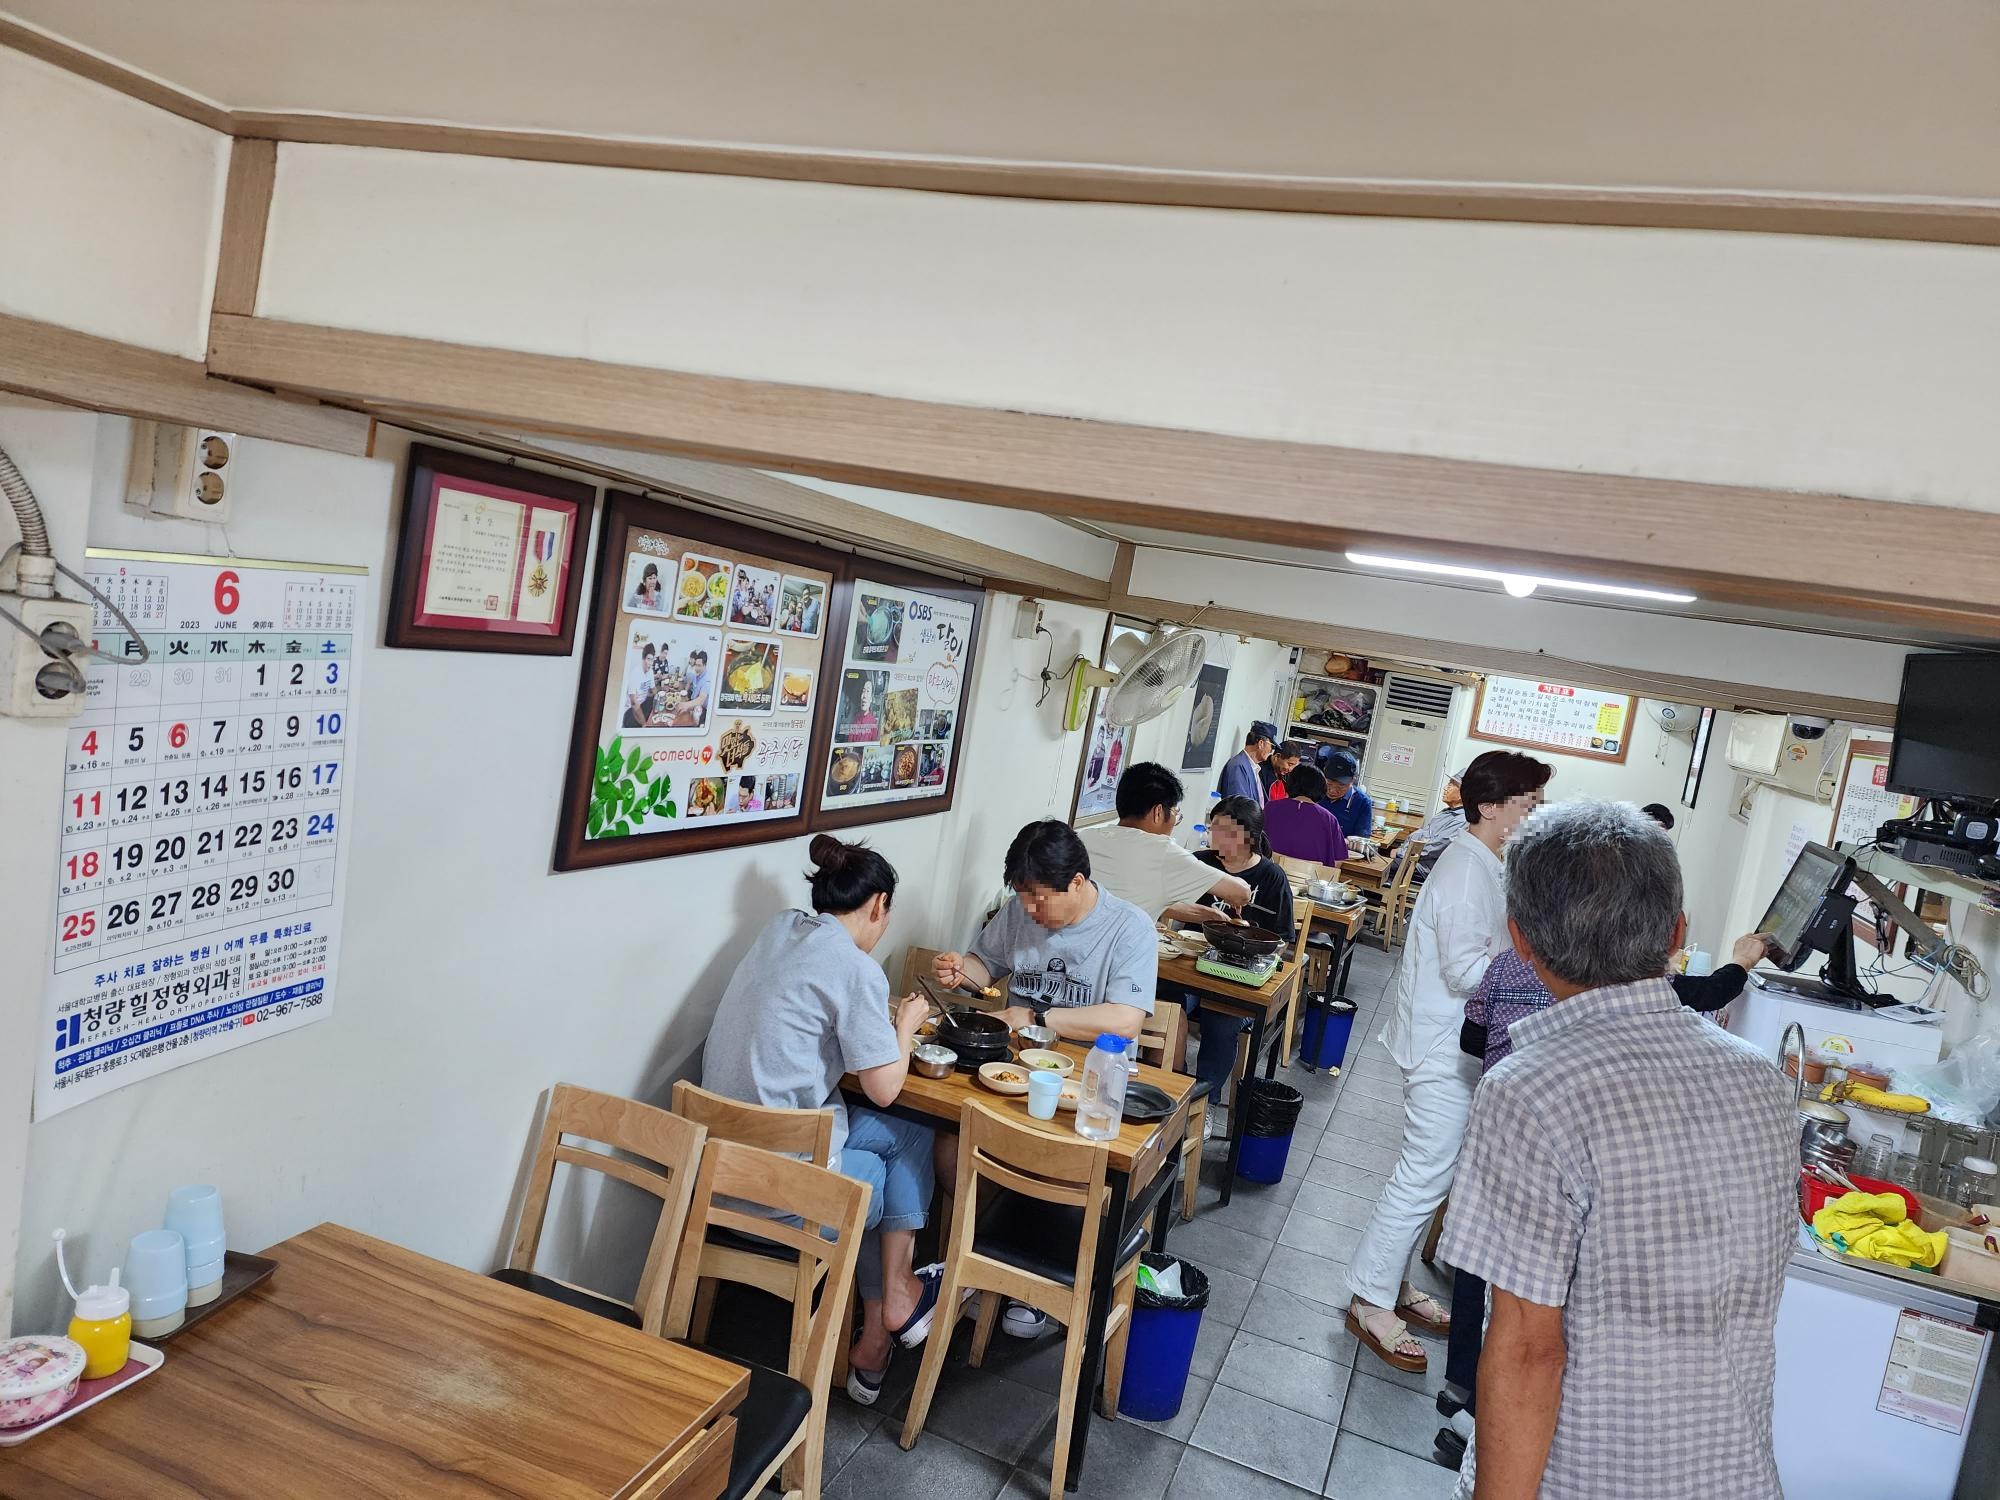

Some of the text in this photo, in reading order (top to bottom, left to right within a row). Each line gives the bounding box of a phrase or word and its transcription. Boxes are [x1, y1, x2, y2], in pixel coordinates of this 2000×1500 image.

[120, 567, 126, 576] 5
[214, 570, 240, 615] 6
[180, 620, 200, 629] 2023
[214, 620, 237, 629] JUNE
[917, 604, 933, 620] SBS
[169, 640, 189, 655] 火
[210, 639, 228, 654] 水
[248, 639, 265, 654] 木
[286, 640, 302, 654] 金
[320, 640, 336, 654] 土
[937, 622, 963, 658] 달인
[129, 663, 338, 687] 29 30 31 1 2 3
[81, 713, 341, 755] 4 5 6 7 8 9 10
[758, 735, 804, 768] 광주식당
[653, 747, 700, 765] comedy
[73, 763, 338, 818] 11 12 13 14 15 16 17
[67, 813, 335, 880] 18 19 20 21 22 23 24
[62, 868, 295, 941] 25 26 27 28 29 30
[95, 922, 311, 989] 주사 치료 잘하는 병원 어깨 무릎 특화진료
[57, 991, 107, 1013] 서울대학교병원
[110, 986, 125, 998] 출신
[127, 976, 155, 992] 대표원장
[164, 967, 190, 982] 정형외과
[193, 962, 212, 975] 전문의
[215, 957, 227, 967] 직접
[80, 991, 240, 1044] REFRESH-HEAL ORTHOPEDICS
[94, 1044, 114, 1058] 클리닉
[143, 1027, 163, 1040] 클리닉
[190, 1014, 206, 1026] DNA
[206, 1009, 219, 1021] 주사
[225, 1003, 244, 1016] 노인성
[53, 1073, 74, 1090] 서울시
[74, 1064, 101, 1083] 동대문구
[130, 1043, 165, 1062] SC제일은행
[257, 993, 323, 1022] 02-967-7588
